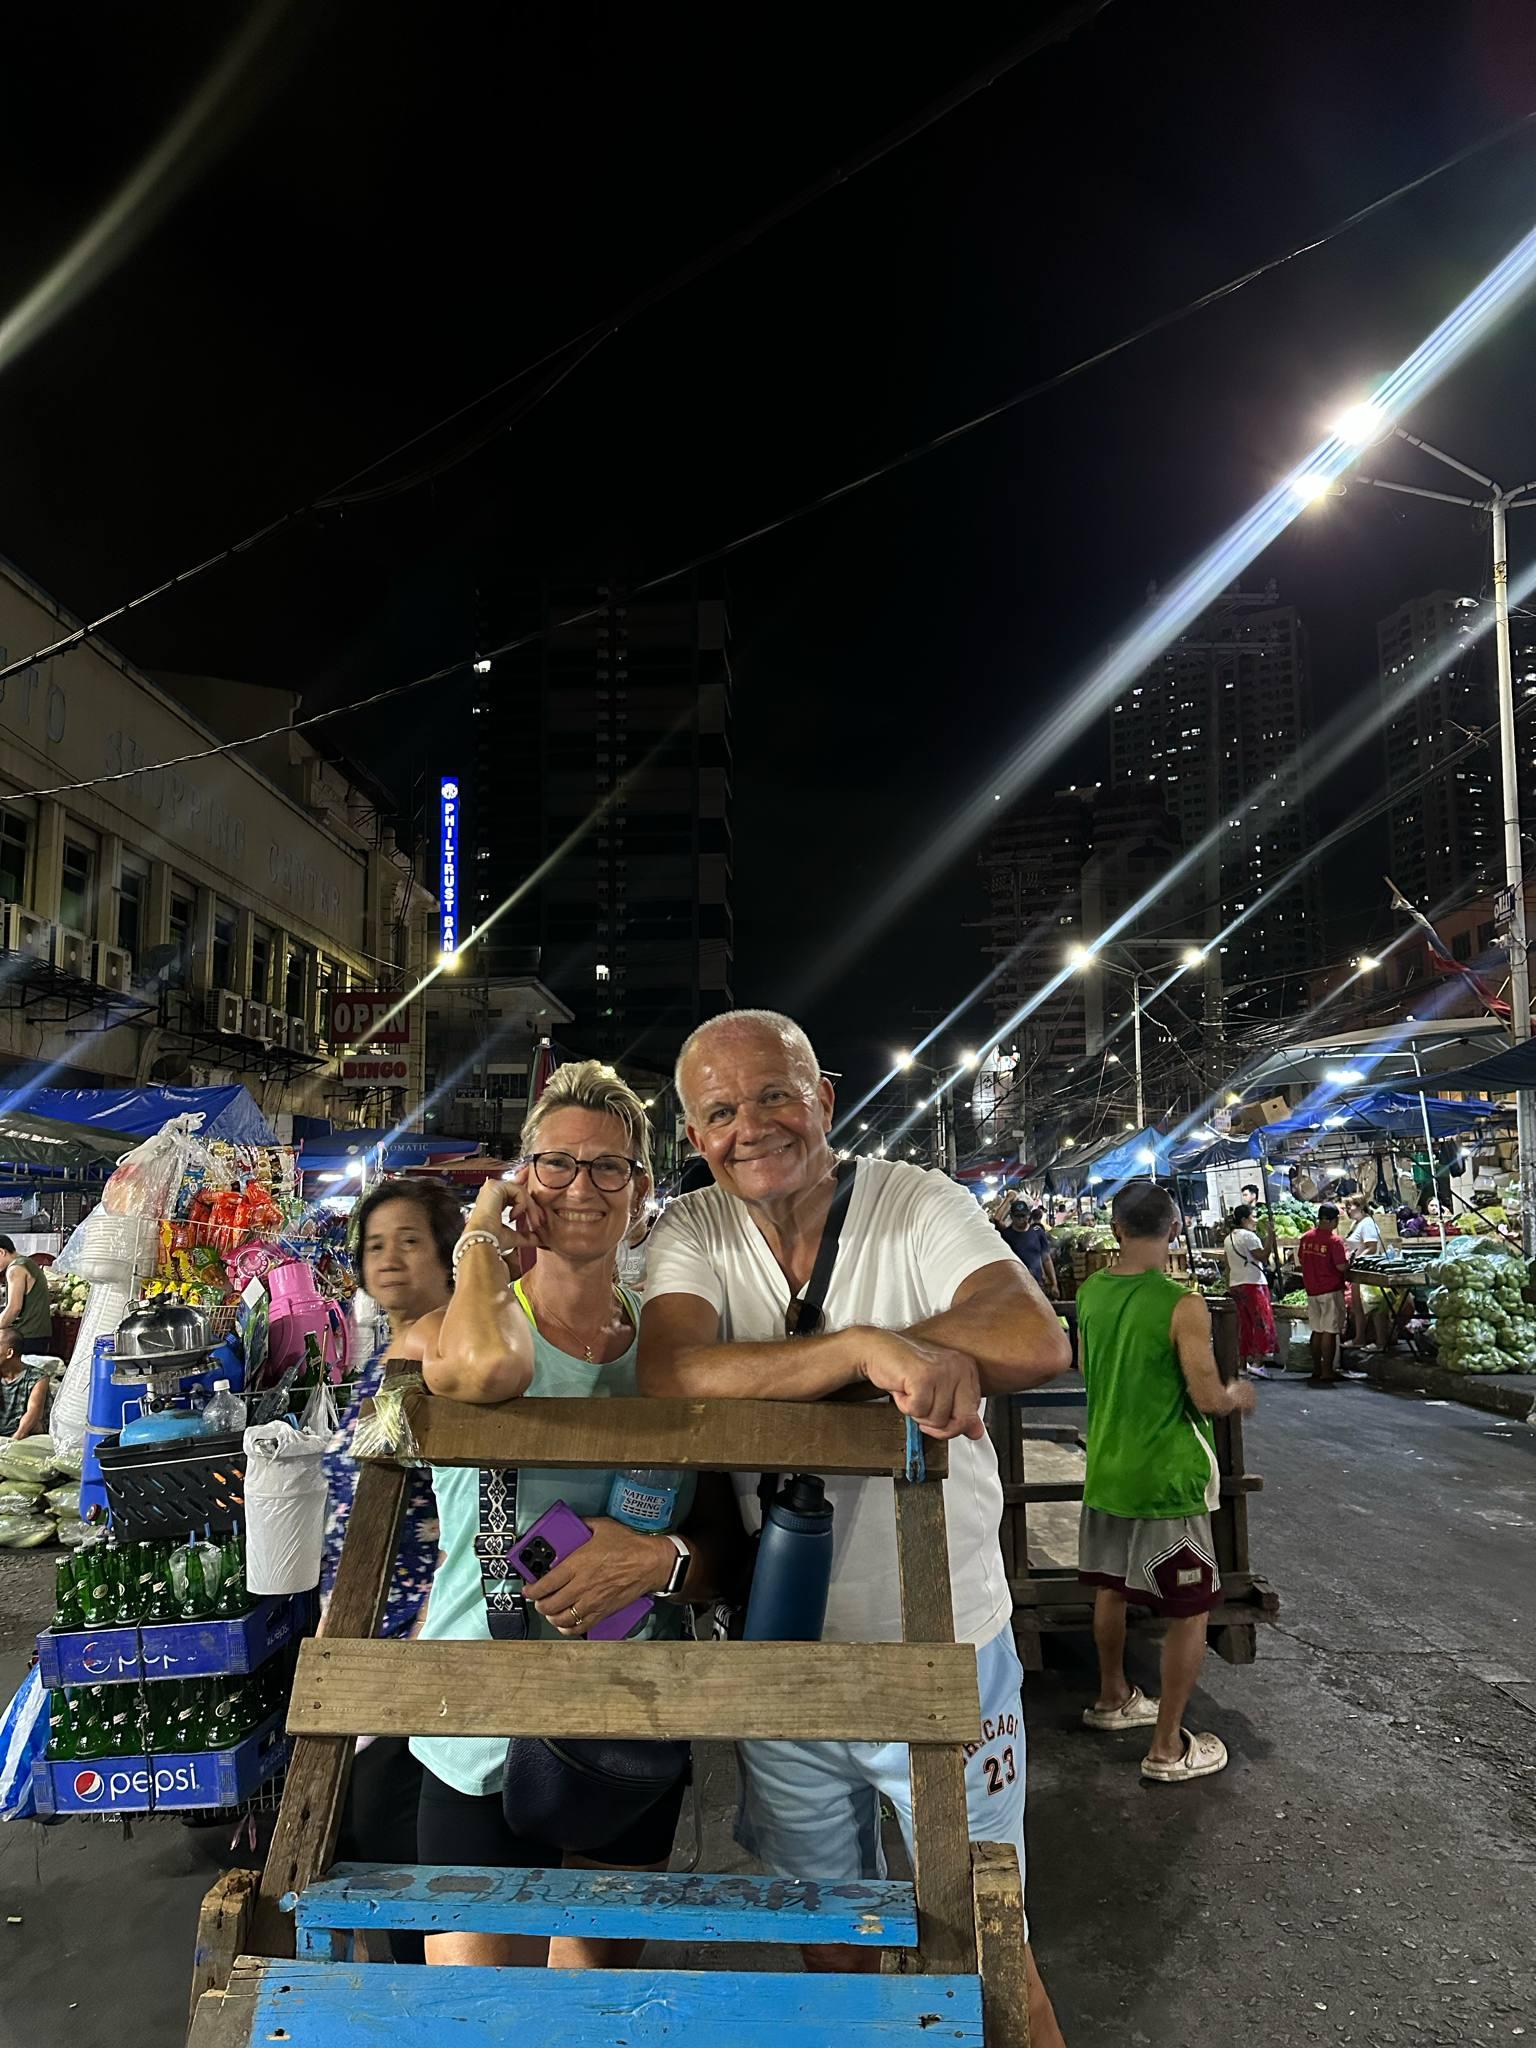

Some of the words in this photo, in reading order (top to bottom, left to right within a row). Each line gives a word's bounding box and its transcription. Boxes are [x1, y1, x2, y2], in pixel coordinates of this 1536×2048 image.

[0, 646, 65, 743] TO
[268, 841, 342, 913] CENTER
[444, 802, 455, 912] PHILTRUST
[334, 1002, 407, 1033] OPEN
[343, 1061, 407, 1079] BINGO
[623, 1488, 667, 1504] NATURE'S
[625, 1498, 661, 1512] SPRING
[110, 1762, 196, 1801] pepsi
[983, 1744, 1016, 1796] 23
